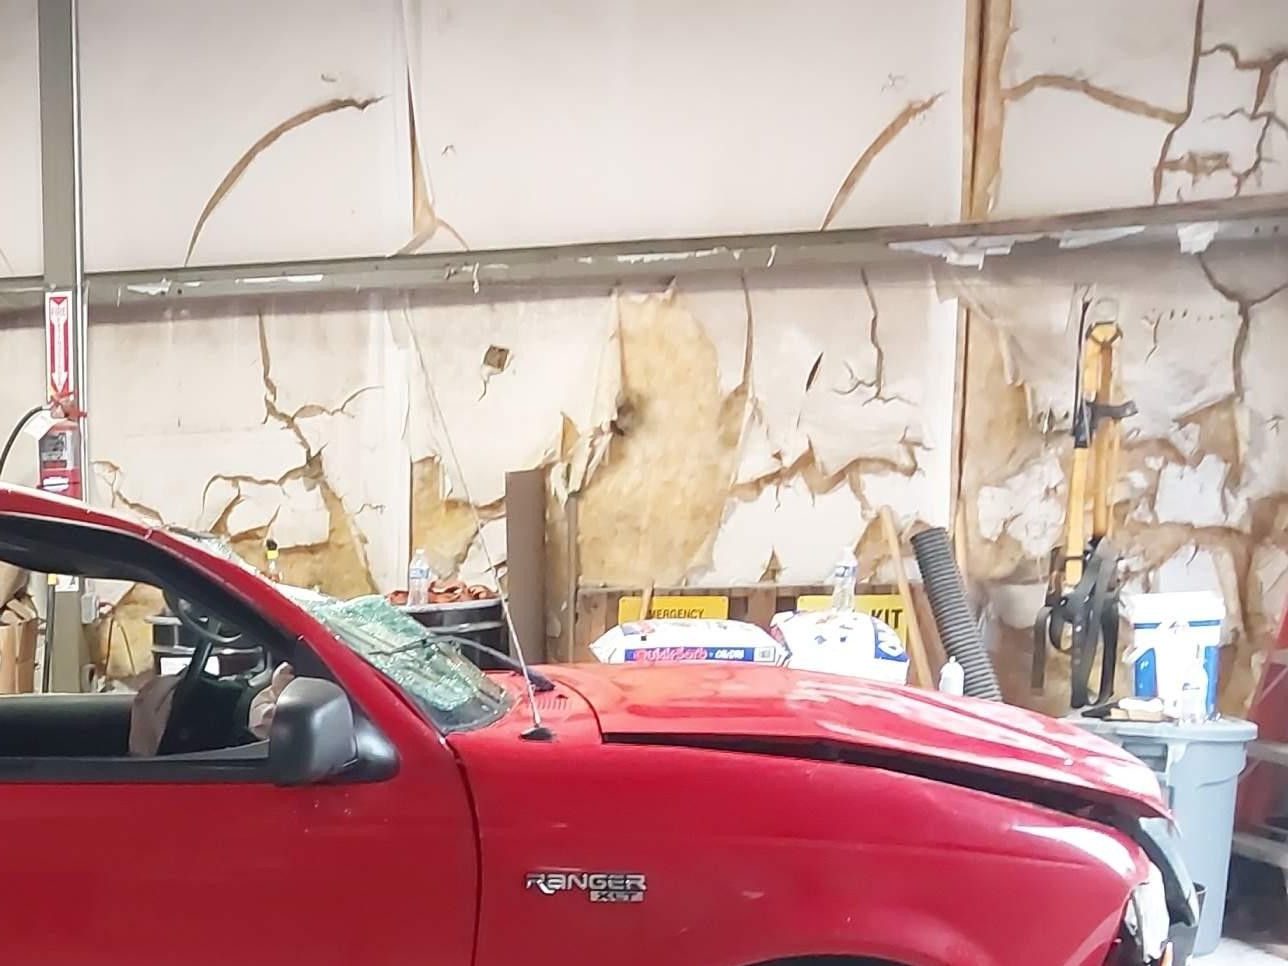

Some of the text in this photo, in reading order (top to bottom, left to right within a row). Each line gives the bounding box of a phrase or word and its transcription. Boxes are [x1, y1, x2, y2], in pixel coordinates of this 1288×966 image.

[648, 608, 705, 620] MERGENCY
[525, 873, 647, 895] RANGER
[594, 891, 640, 901] XLT
